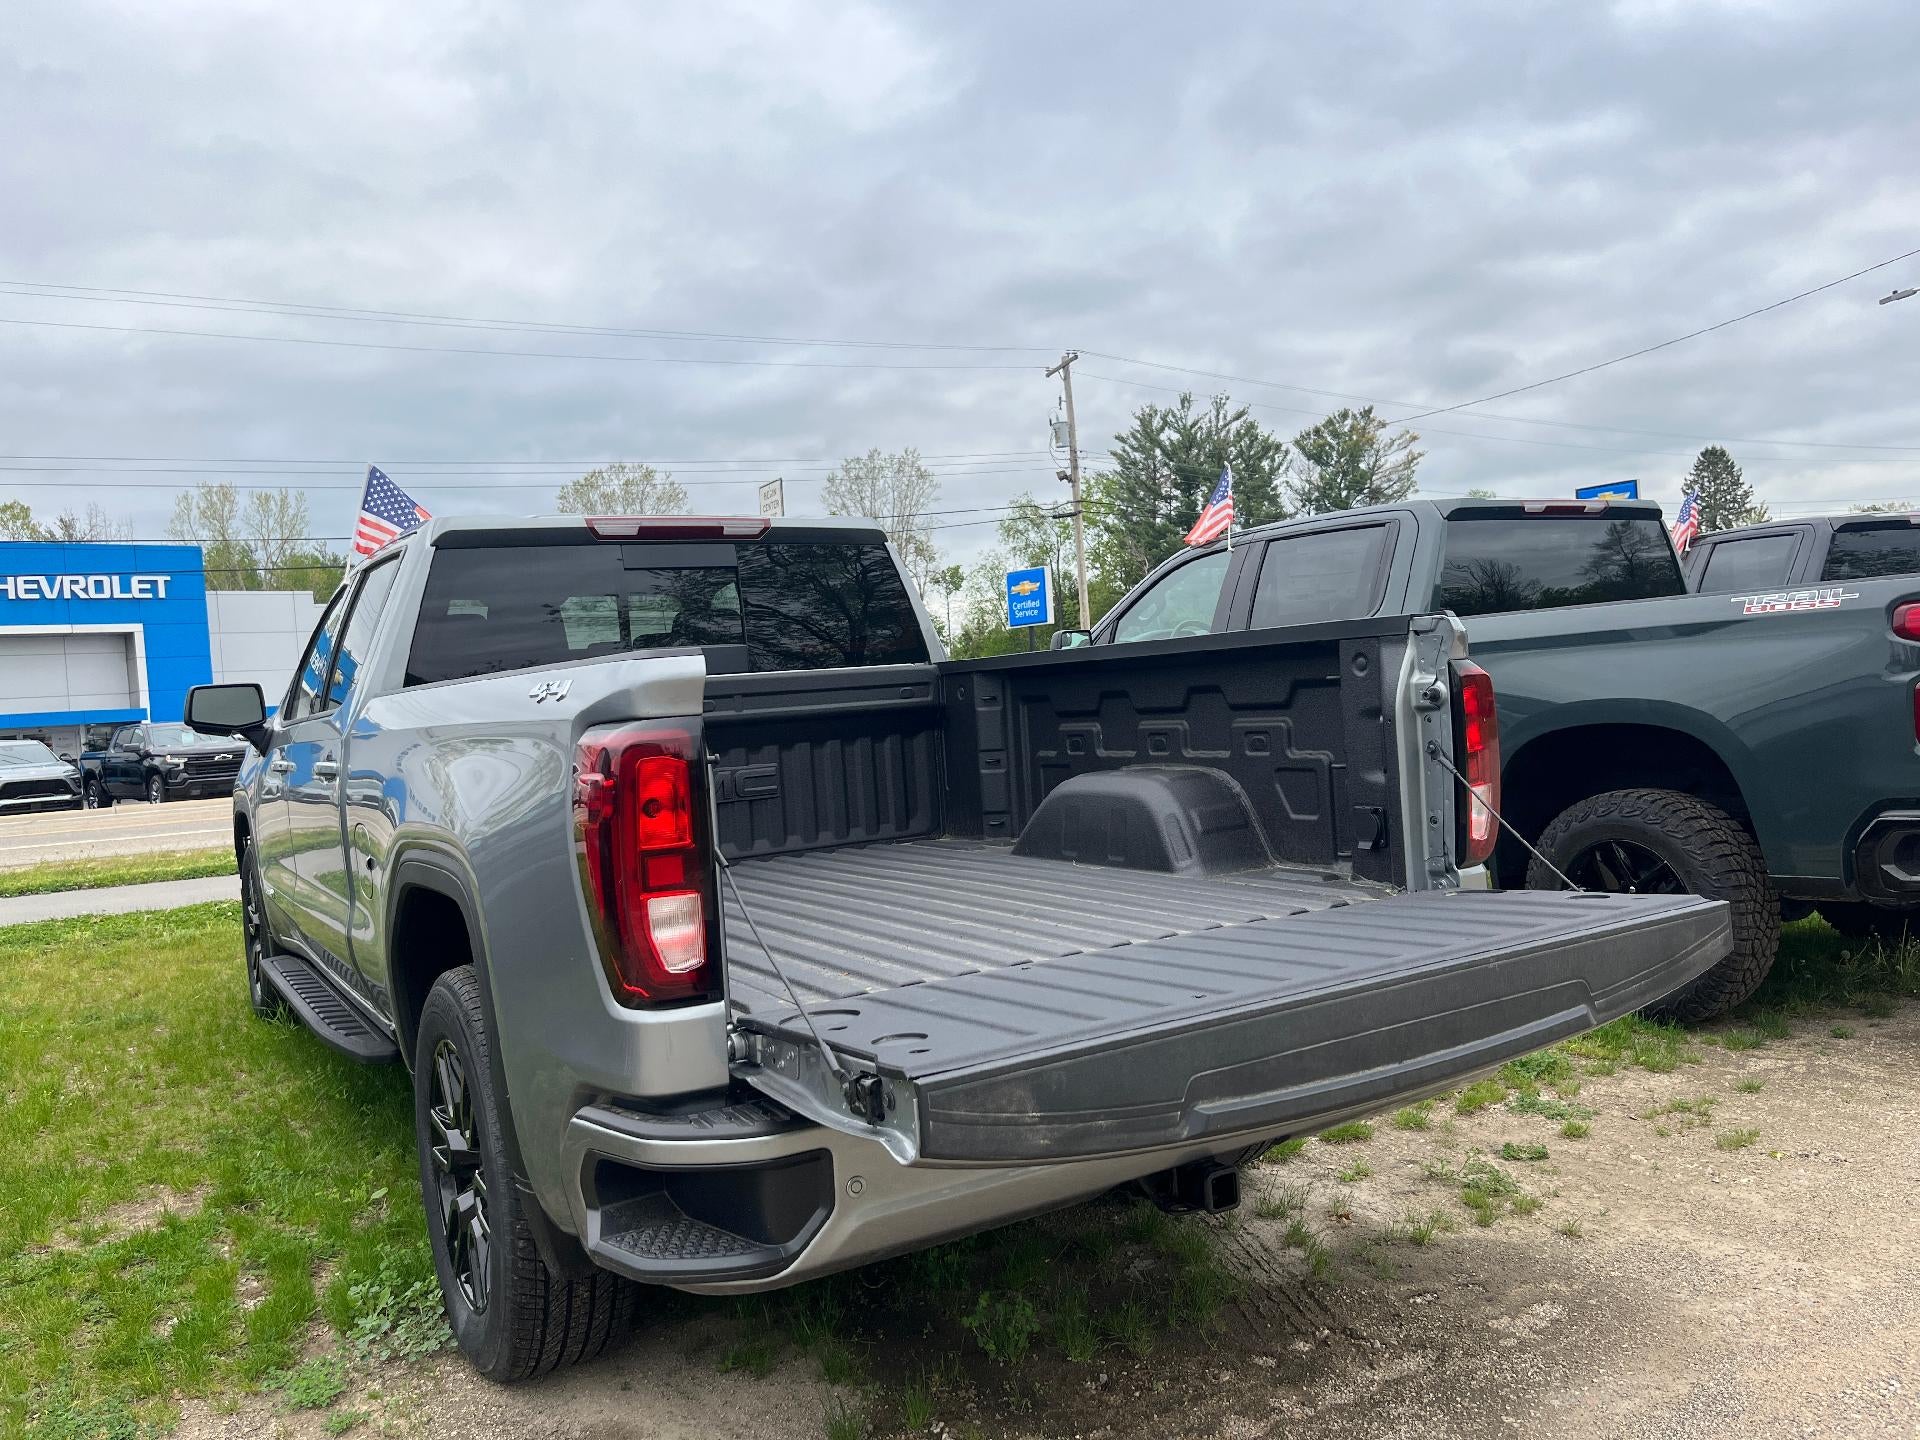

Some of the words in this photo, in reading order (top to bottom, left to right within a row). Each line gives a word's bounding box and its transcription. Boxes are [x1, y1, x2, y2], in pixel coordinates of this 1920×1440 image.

[763, 499, 779, 512] CENTER
[1731, 588, 1859, 606] TRAIL
[1012, 600, 1040, 610] Certified
[1743, 600, 1841, 614] BOSS
[1014, 609, 1039, 618] Service
